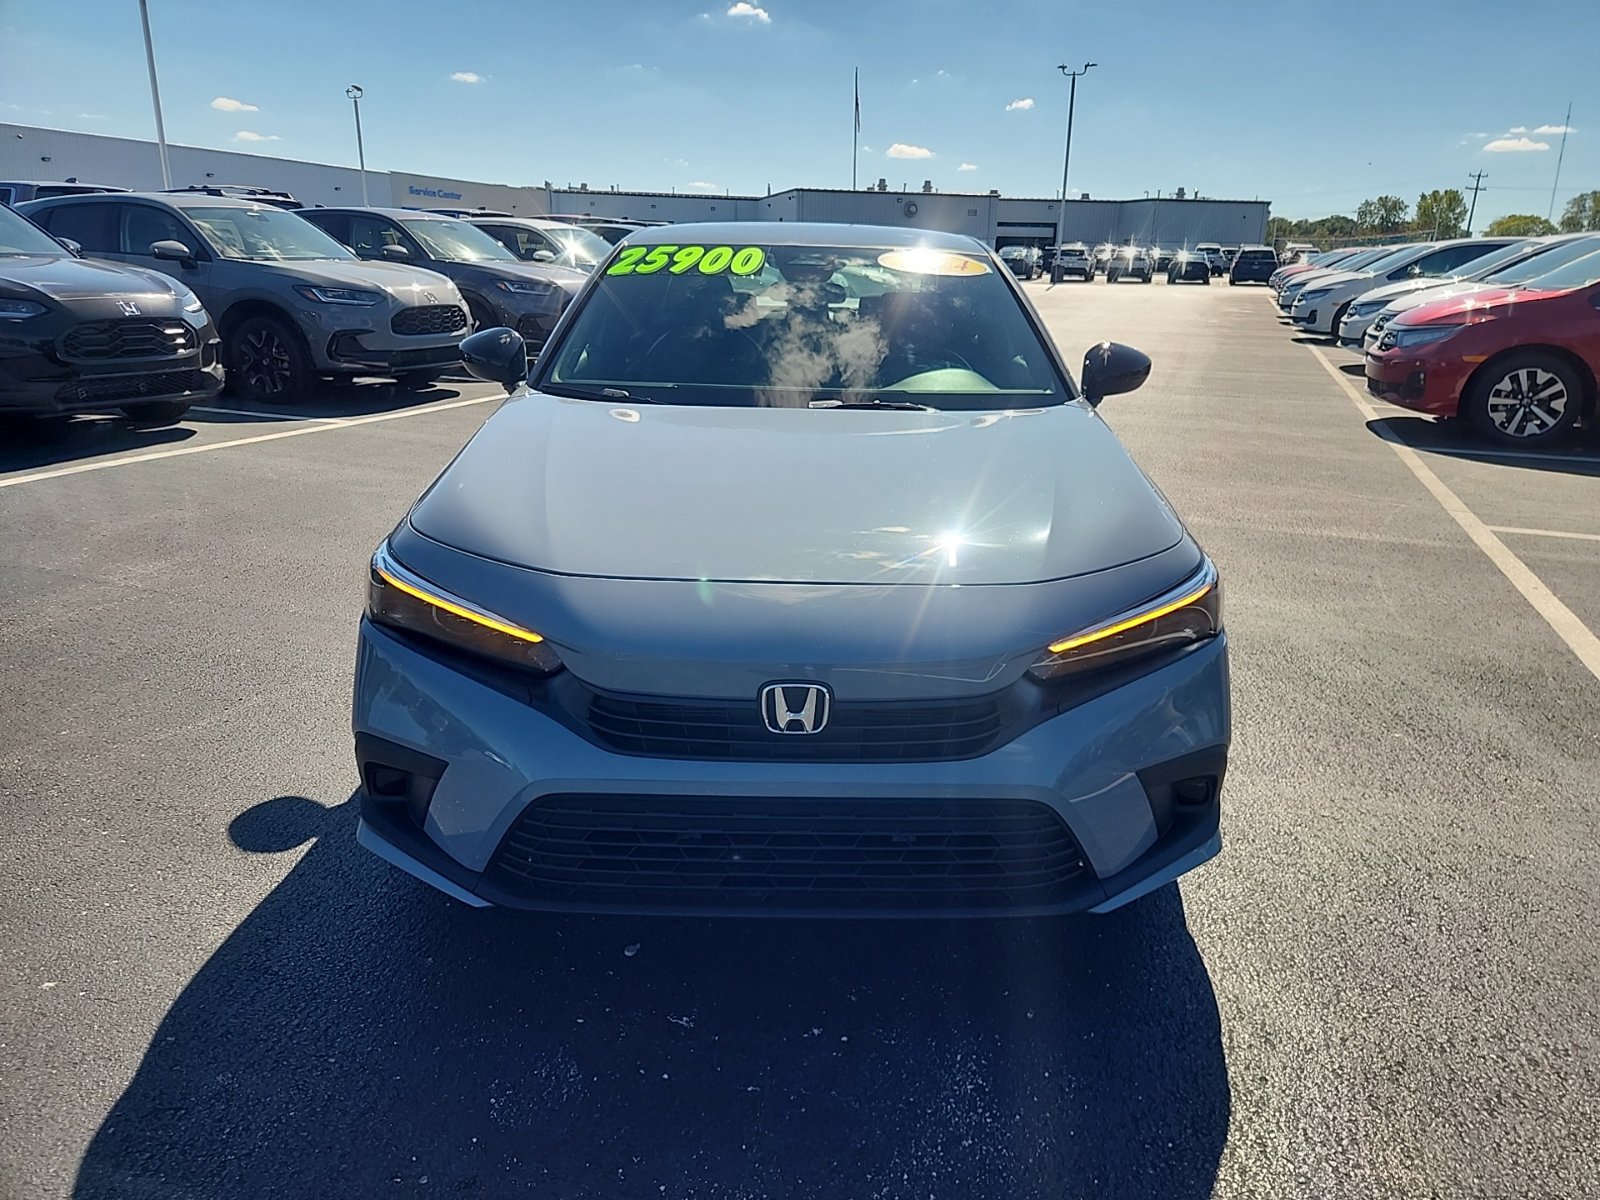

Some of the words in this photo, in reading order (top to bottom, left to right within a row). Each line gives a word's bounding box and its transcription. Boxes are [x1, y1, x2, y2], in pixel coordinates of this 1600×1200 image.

[409, 185, 436, 198] Service
[437, 189, 462, 200] Center
[606, 245, 765, 276] 25900
